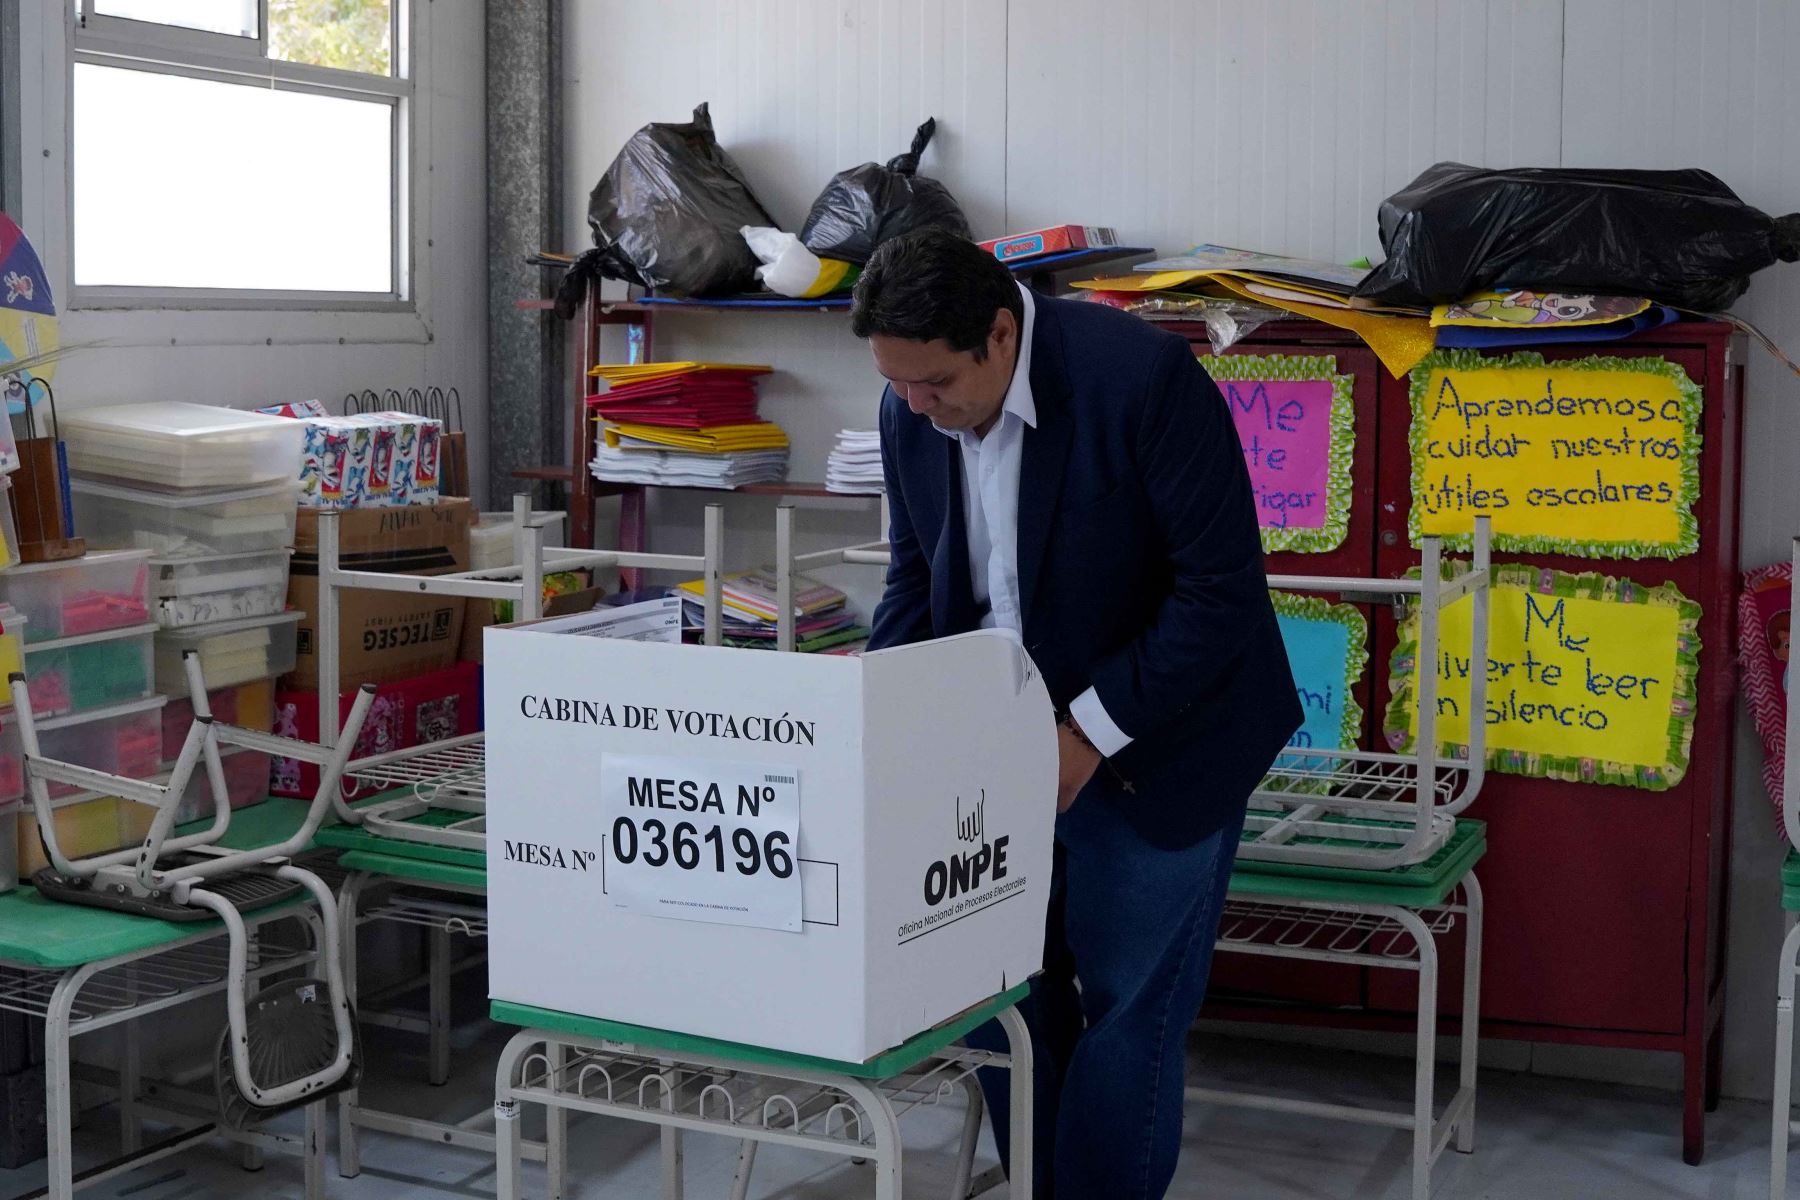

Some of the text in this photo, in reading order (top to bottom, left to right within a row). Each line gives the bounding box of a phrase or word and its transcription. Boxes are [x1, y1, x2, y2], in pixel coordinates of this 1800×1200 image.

[1226, 383, 1304, 432] Me
[1427, 424, 1681, 460] cuidar nuestros
[1526, 469, 1673, 506] escolares
[363, 622, 429, 651] TECSEG
[1524, 592, 1590, 652] Me
[1586, 657, 1660, 699] leer
[520, 695, 816, 746] CABINA DE VOTACIÓN
[627, 776, 725, 815] MESA
[503, 839, 567, 869] MESA
[612, 816, 794, 879] 036196
[924, 835, 1010, 906] ONPE
[898, 876, 1027, 937] Oficina Nacional de Procesos Electorales
